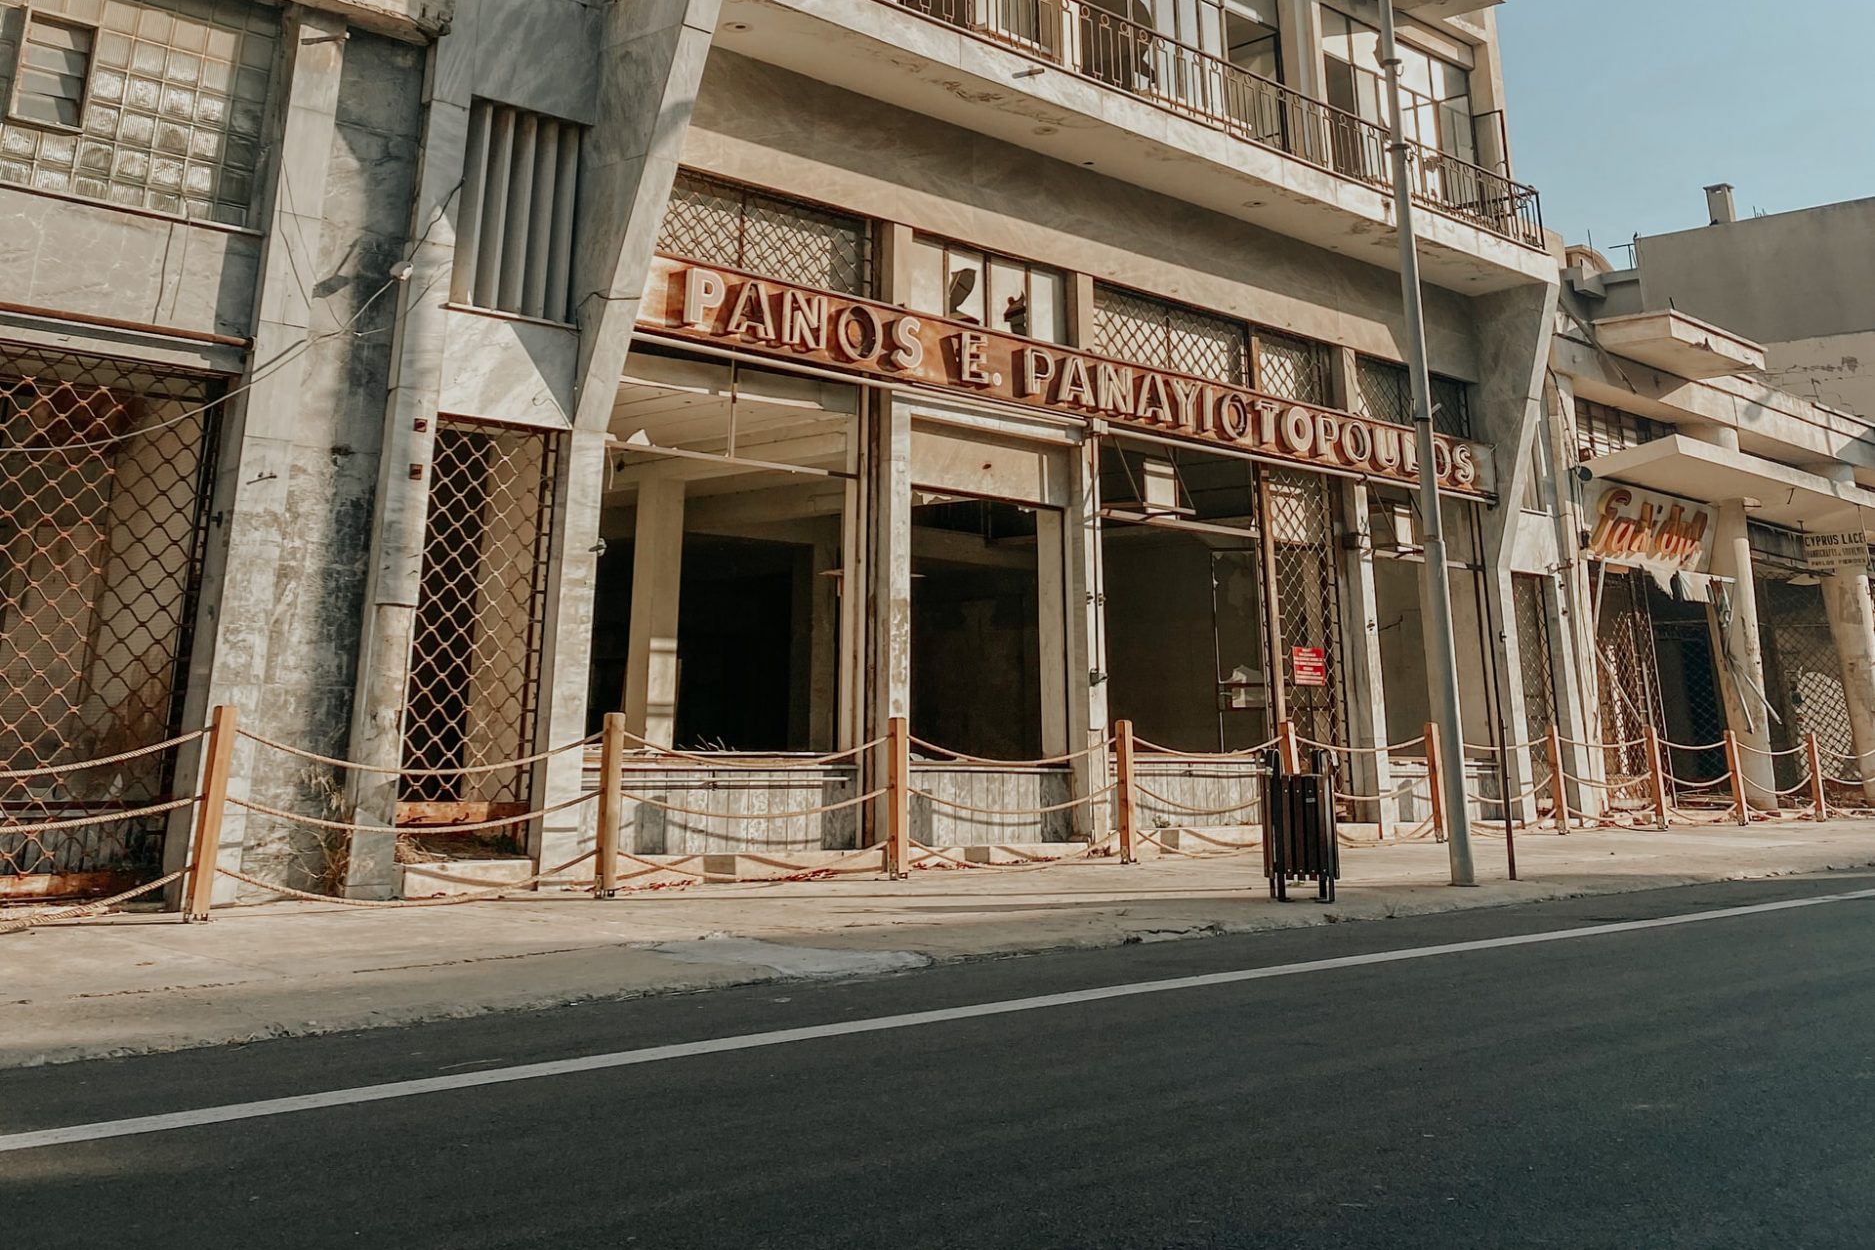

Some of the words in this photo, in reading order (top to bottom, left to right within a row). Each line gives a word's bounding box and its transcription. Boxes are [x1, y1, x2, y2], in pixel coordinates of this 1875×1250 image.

[683, 267, 924, 369] PANOS
[961, 331, 1002, 386] E.
[1024, 347, 1475, 485] PANAYIOTOPOULOS
[1804, 534, 1839, 547] CYPRUS
[1841, 532, 1867, 545] LACE
